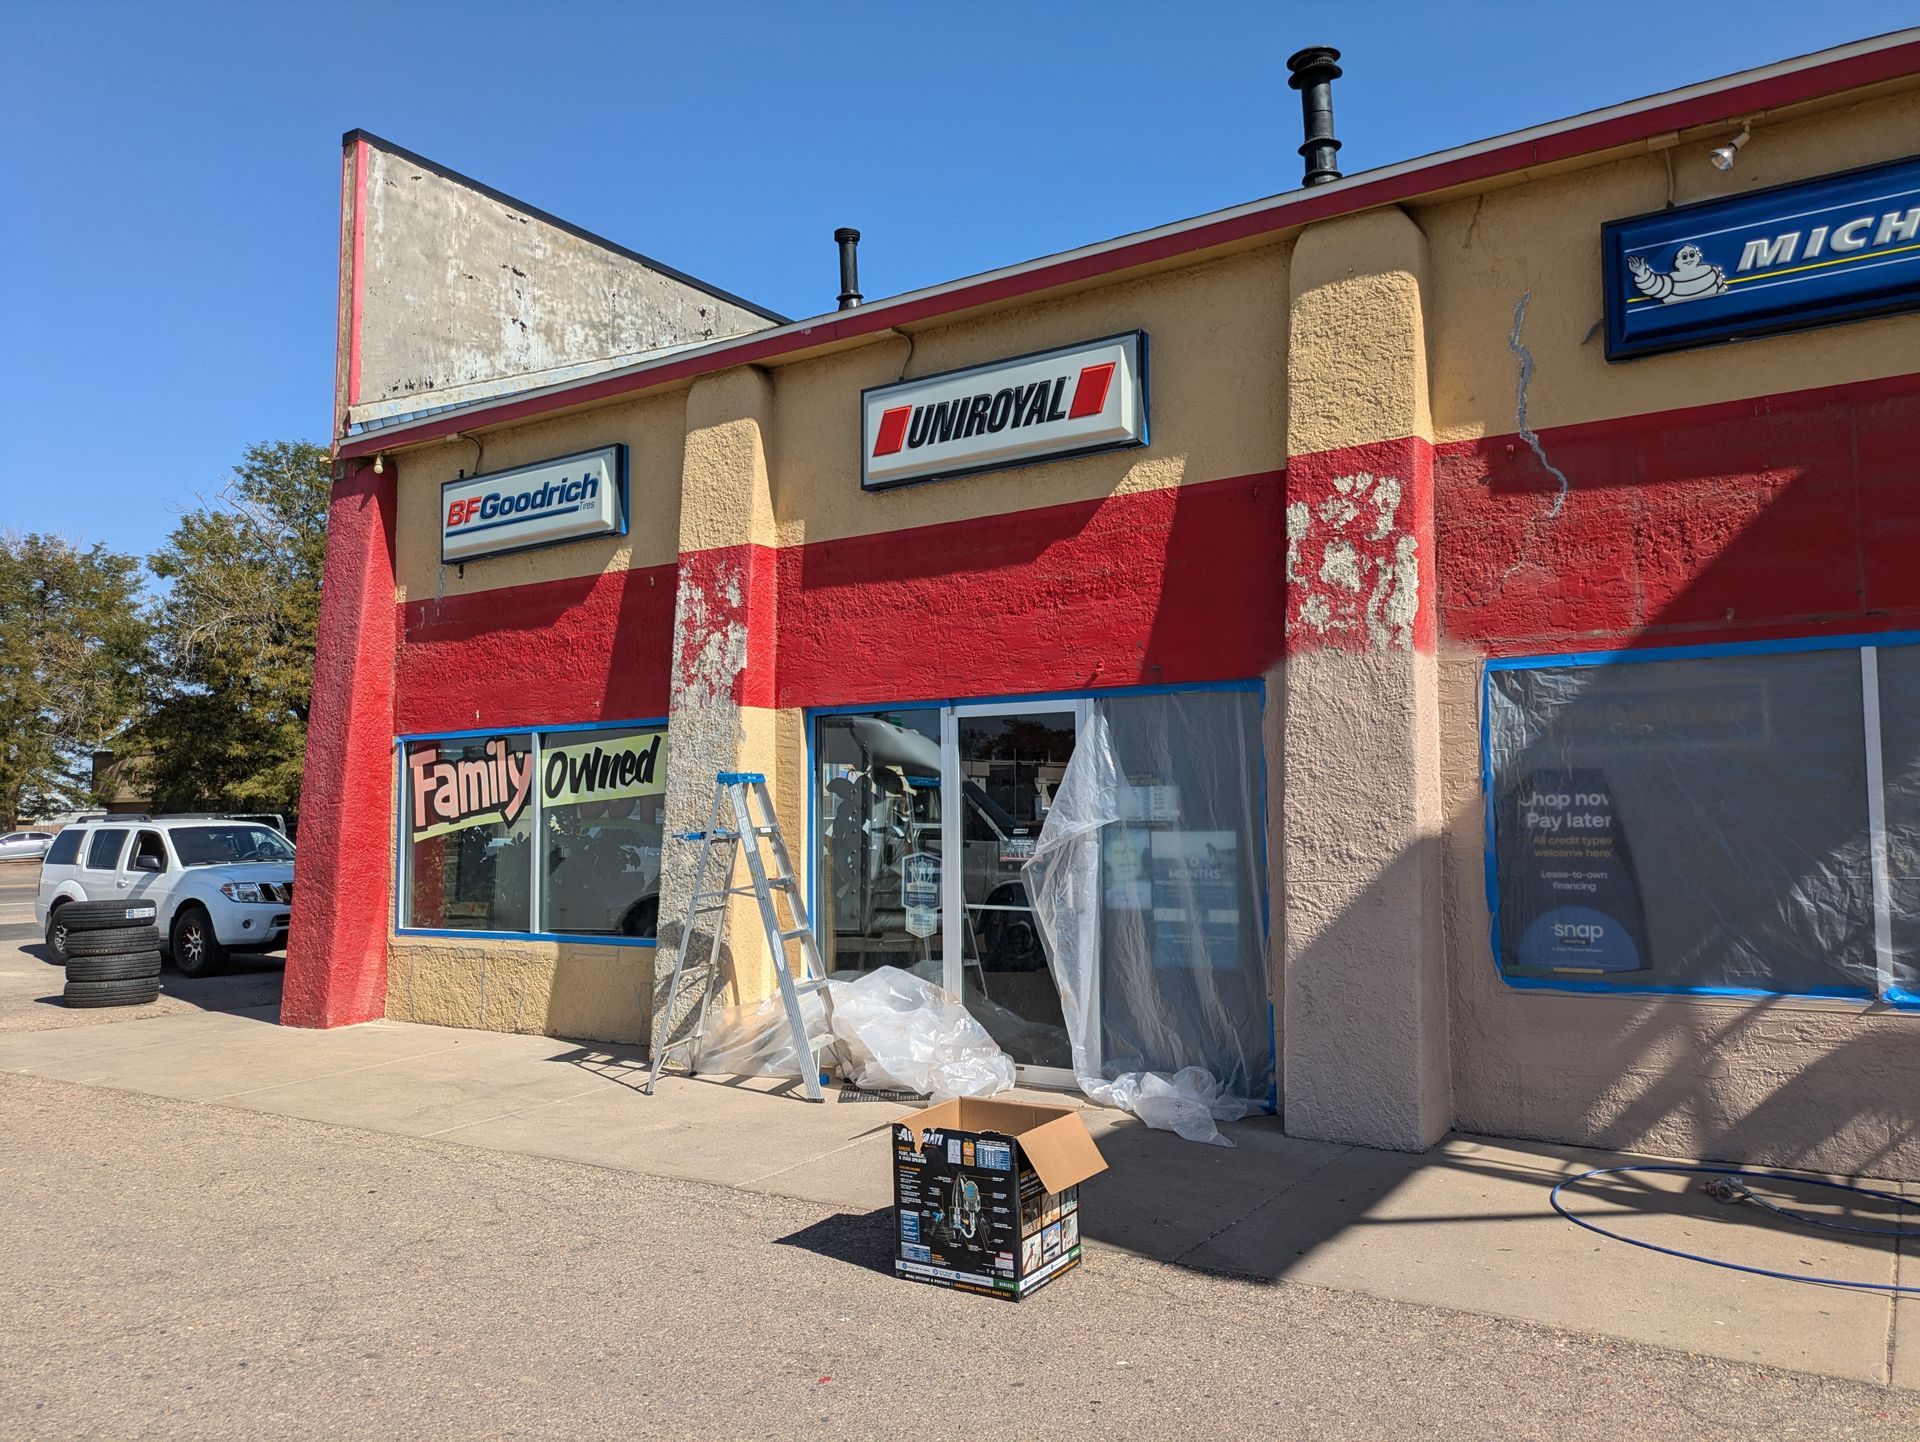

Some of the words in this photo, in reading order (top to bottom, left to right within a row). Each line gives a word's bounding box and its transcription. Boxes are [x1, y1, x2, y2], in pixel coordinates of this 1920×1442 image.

[906, 376, 1067, 449] UNIROYAL
[446, 472, 599, 527] BFGoodrich
[578, 500, 595, 512] Tires
[409, 738, 533, 829] Family
[1527, 812, 1562, 832] Pay
[1566, 812, 1611, 828] later
[1548, 835, 1580, 845] credit
[1534, 848, 1583, 858] welcome
[1541, 870, 1608, 879] Lease-to-own
[1552, 881, 1597, 892] financing
[1553, 923, 1604, 943] snap
